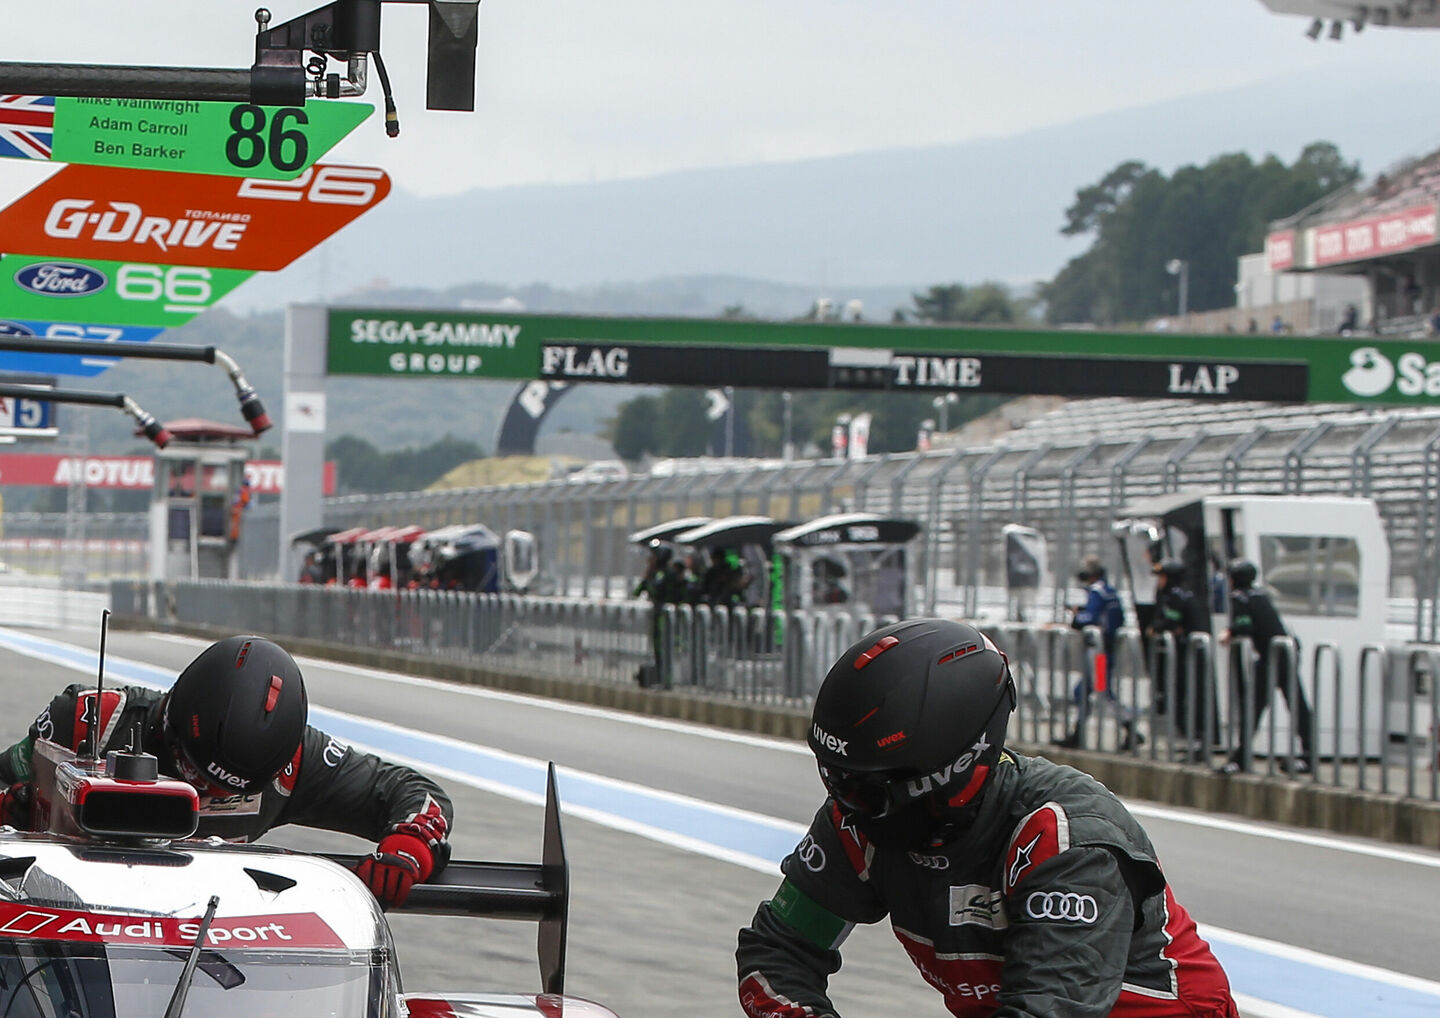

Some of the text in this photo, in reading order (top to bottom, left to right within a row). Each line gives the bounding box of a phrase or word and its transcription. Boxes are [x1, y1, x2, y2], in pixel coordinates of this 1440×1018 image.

[89, 116, 189, 137] Adam Carroll
[224, 104, 310, 171] 86
[94, 141, 186, 160] Ben Barker
[31, 263, 212, 303] Ford 66
[389, 352, 483, 374] GROUP
[542, 345, 1240, 394] FLAG TIME LAP
[20, 399, 44, 426] 5
[55, 455, 154, 487] MOTUL
[813, 722, 849, 757] uvex
[876, 730, 907, 748] uvex
[207, 762, 251, 789] uvex
[908, 732, 991, 797] uvex
[58, 918, 294, 944] Audi Sport
[957, 982, 1002, 1000] Spo
